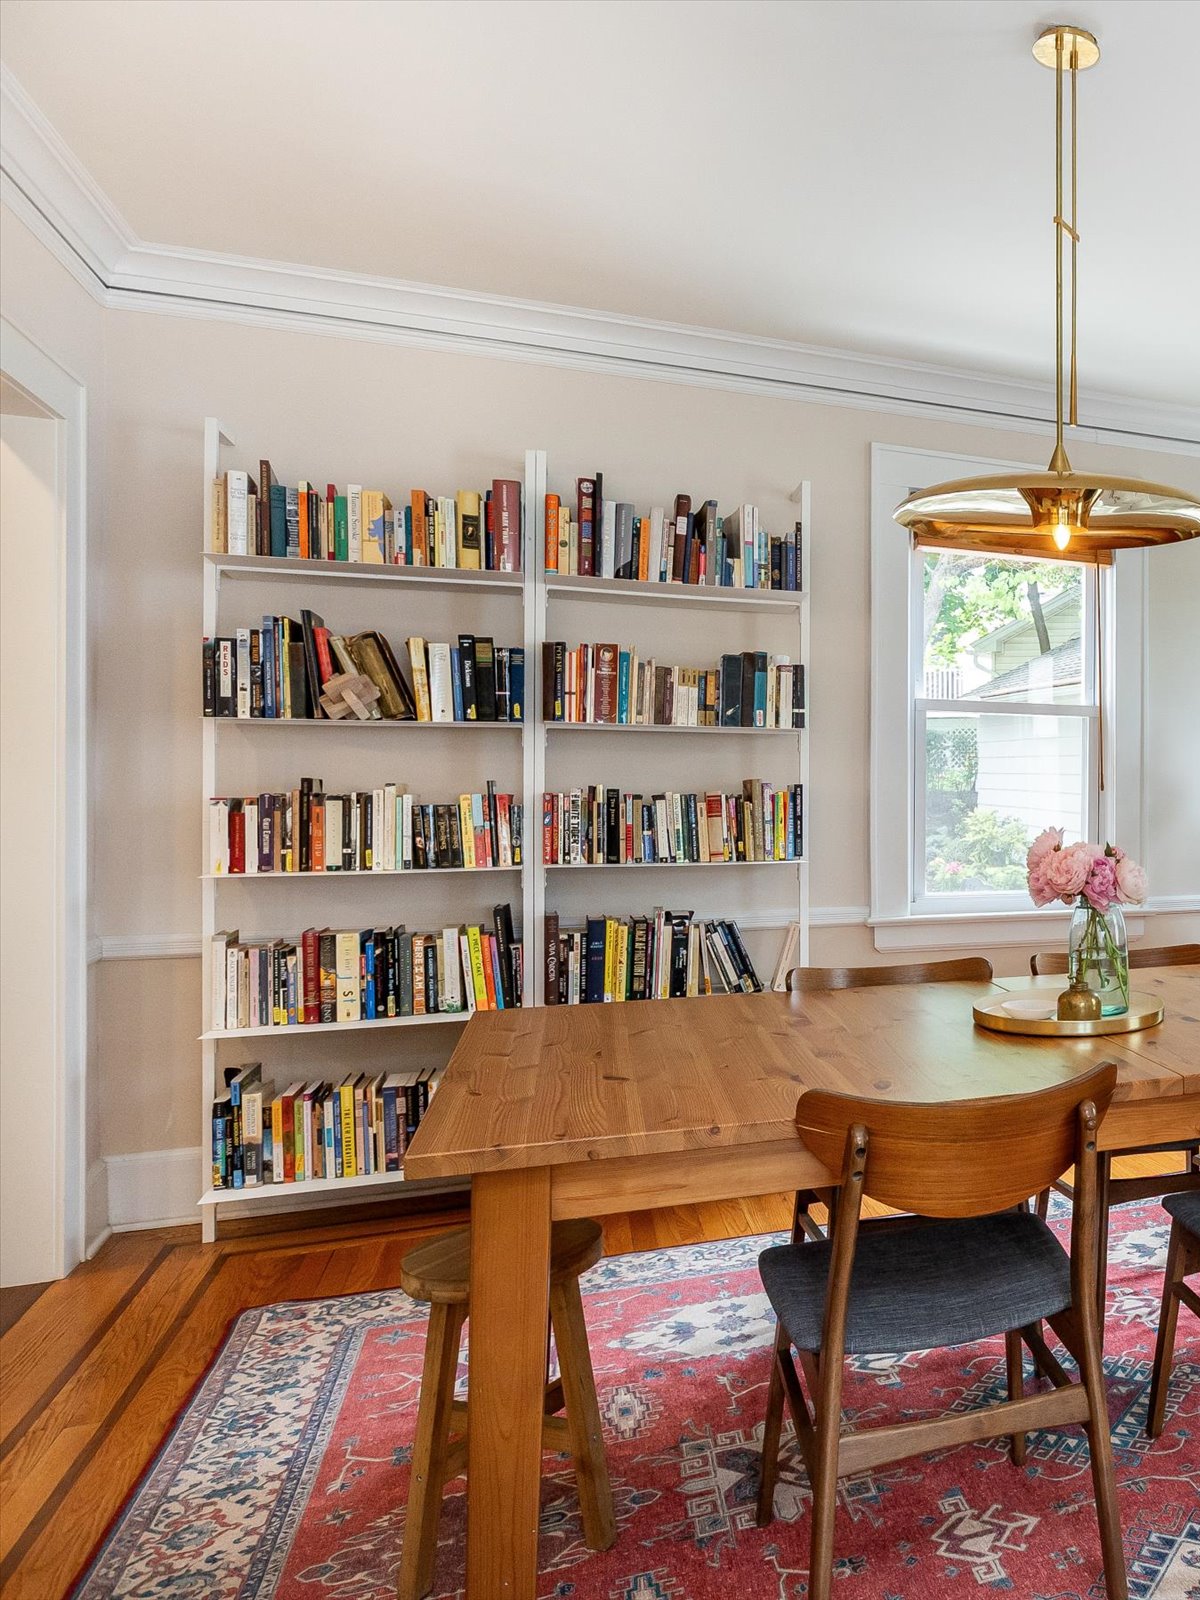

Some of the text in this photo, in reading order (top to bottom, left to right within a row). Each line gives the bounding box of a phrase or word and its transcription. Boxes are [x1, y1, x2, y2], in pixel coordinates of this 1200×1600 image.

[352, 492, 360, 542] Human Smoke
[429, 517, 434, 525] WE
[464, 660, 472, 687] Dickinson
[572, 800, 580, 820] WHITE
[572, 821, 580, 844] TIGER
[634, 924, 646, 941] BLACK
[415, 940, 423, 964] HERE
[547, 942, 557, 982] VIA CAROTA
[634, 950, 646, 976] HISTORY
[415, 975, 423, 989] AM
[214, 1119, 224, 1159] critical theory
[344, 1137, 352, 1168] EDUCATION
